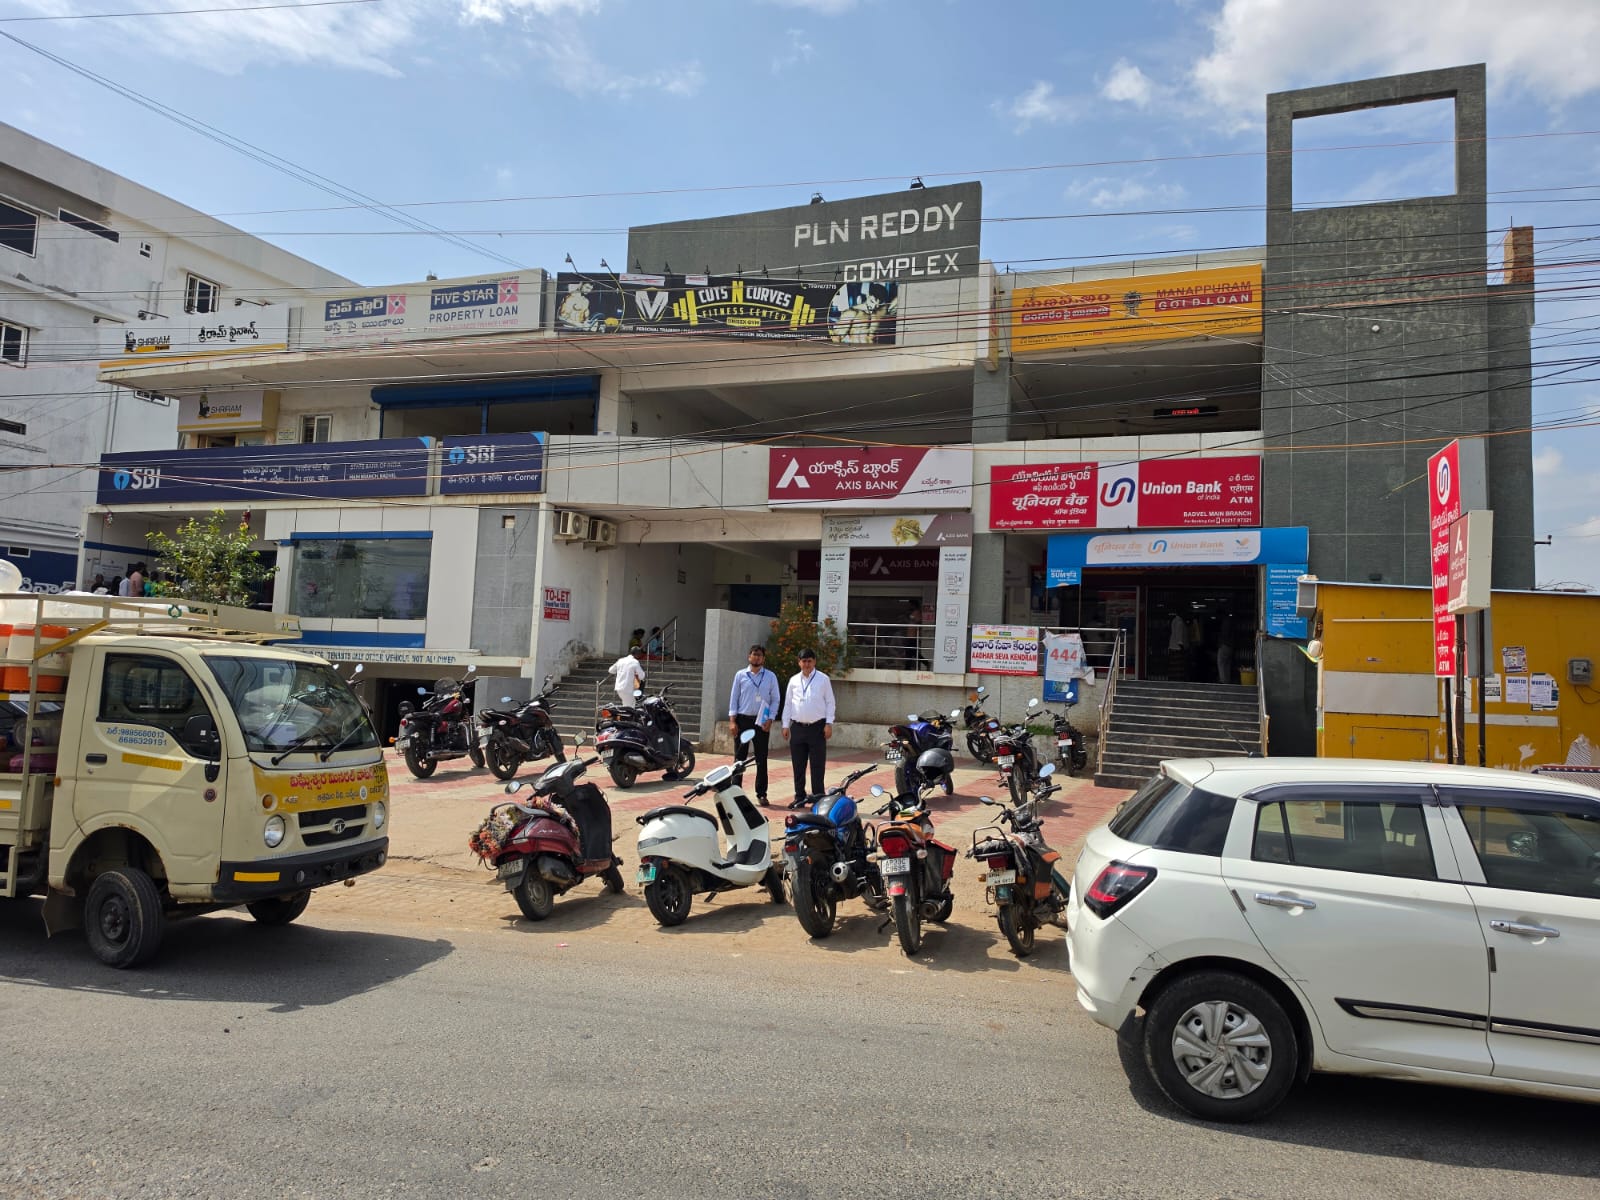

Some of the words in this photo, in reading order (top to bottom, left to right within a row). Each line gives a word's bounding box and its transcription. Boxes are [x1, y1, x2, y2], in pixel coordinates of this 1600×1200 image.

[794, 218, 849, 248] PLN
[860, 201, 963, 240] REDDY
[843, 252, 960, 282] COMPLEX
[698, 286, 729, 303] CUTS
[731, 280, 744, 304] N
[1156, 280, 1251, 298] MANAPPURAM
[434, 291, 460, 306] FIVE
[463, 288, 495, 303] STAR
[746, 286, 792, 308] CURVES
[1206, 293, 1250, 306] LOAN
[354, 298, 384, 315] స్టార్
[429, 308, 484, 323] PROPERTY
[489, 305, 518, 318] LOAN
[702, 307, 744, 319] FITNESS
[750, 307, 787, 321] CENTER
[229, 321, 259, 342] ఫైనాన్స్
[137, 335, 171, 347] SHRIRAM
[211, 404, 242, 414] SHRIRAM
[466, 445, 495, 464] SBI
[808, 459, 860, 478] యాక్సిస్
[862, 458, 903, 479] బ్యాంక్
[130, 468, 161, 489] SBI
[507, 473, 538, 481] e-Corner
[835, 480, 862, 490] AXIS
[865, 480, 899, 490] BANK
[1142, 481, 1182, 495] Union
[1186, 480, 1222, 494] Bank
[1012, 493, 1062, 511] यूनियन
[1065, 492, 1089, 506] बैंक
[1230, 496, 1254, 504] ATM
[1169, 541, 1199, 550] Union
[1199, 540, 1225, 550] Bank
[888, 559, 911, 568] AXIS
[1434, 573, 1448, 589] Union
[544, 588, 571, 602] TO-LET
[1012, 639, 1038, 654] కేంద్రం
[411, 655, 423, 663] NOT
[995, 652, 1009, 660] SEVA
[1049, 648, 1078, 662] 444
[1438, 660, 1450, 672] ATM
